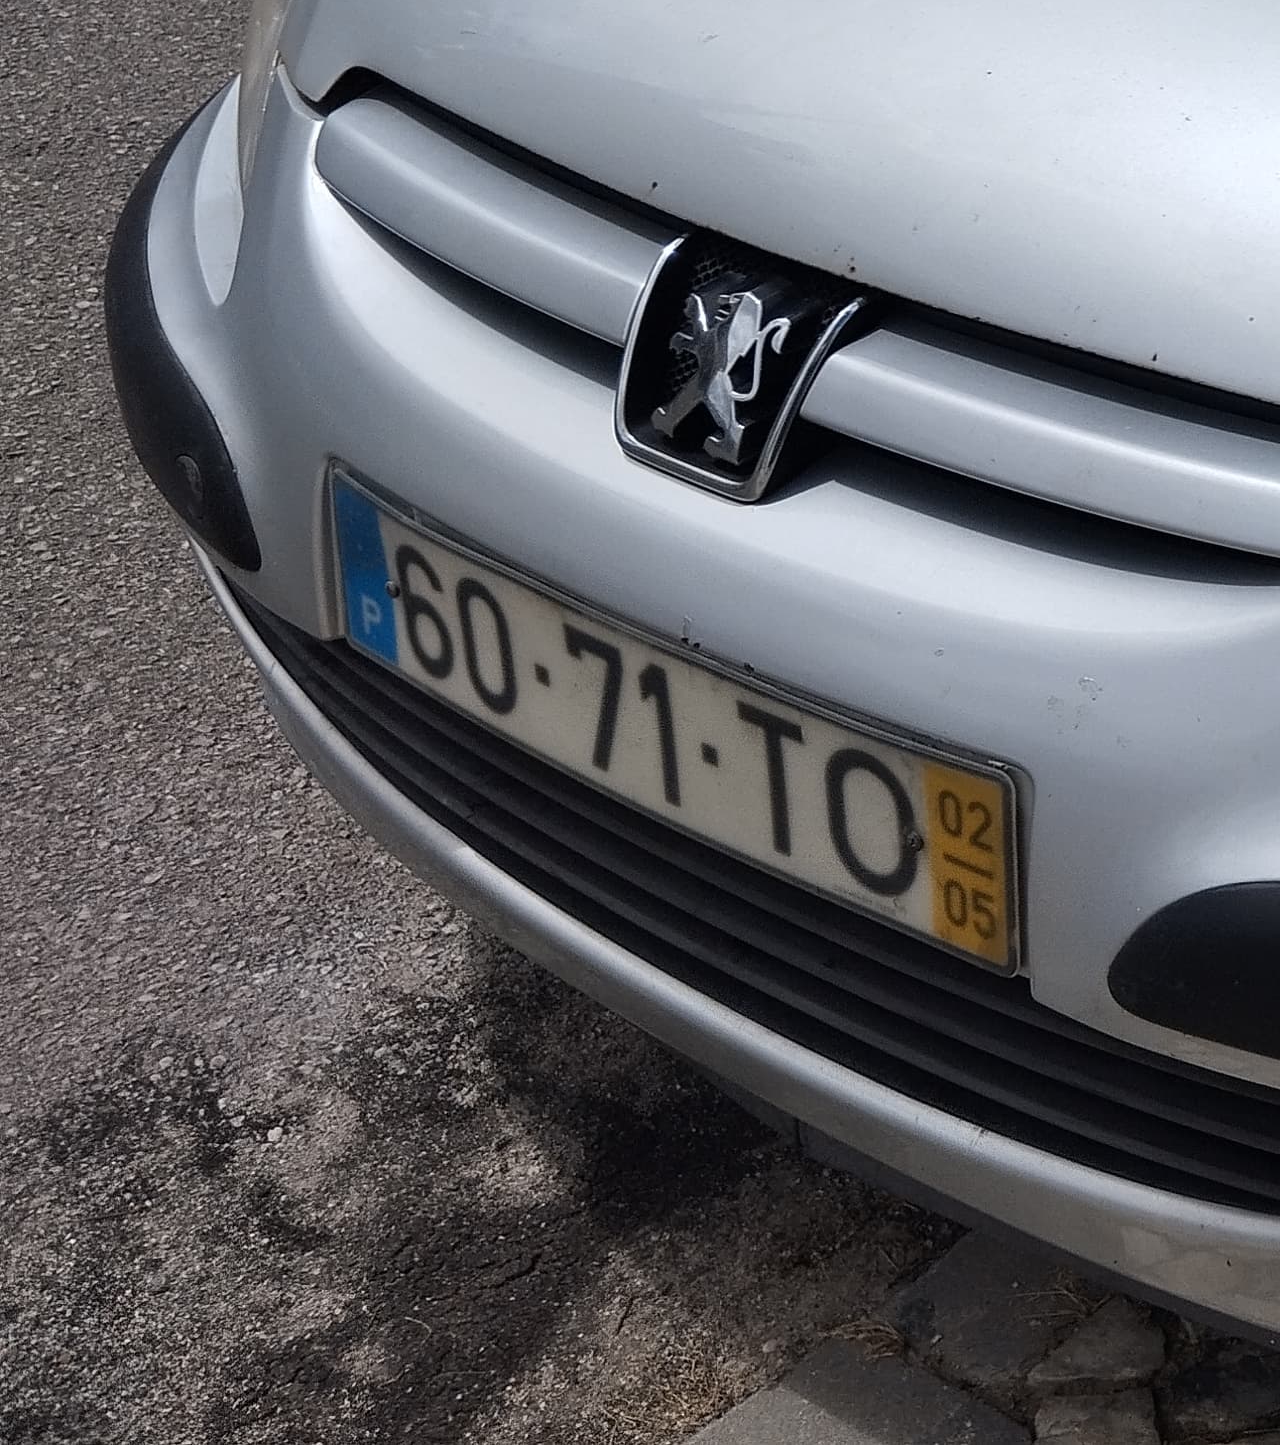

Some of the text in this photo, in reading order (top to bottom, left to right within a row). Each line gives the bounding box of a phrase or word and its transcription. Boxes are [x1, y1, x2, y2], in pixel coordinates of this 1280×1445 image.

[361, 593, 382, 635] P
[938, 789, 993, 853] 02
[943, 877, 997, 940] 05
